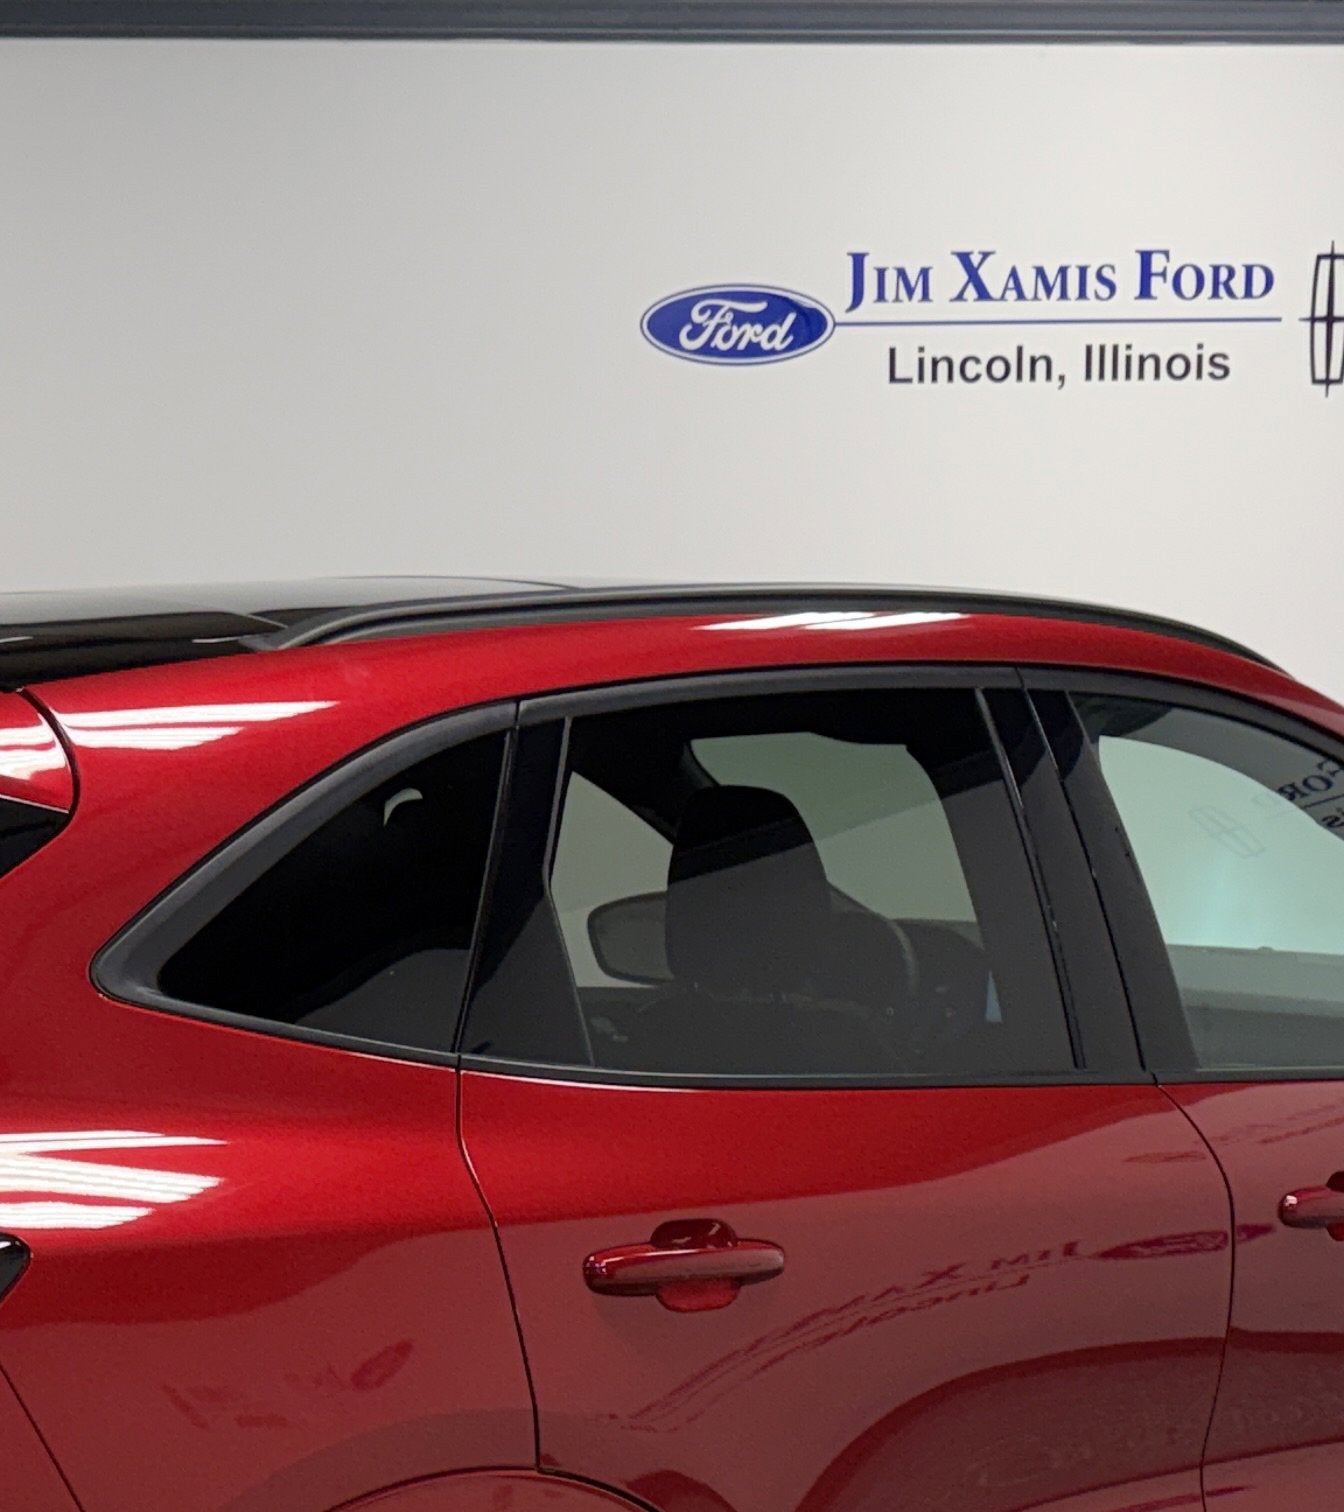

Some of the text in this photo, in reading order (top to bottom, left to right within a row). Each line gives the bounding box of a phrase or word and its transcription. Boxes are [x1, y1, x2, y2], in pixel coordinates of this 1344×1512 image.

[845, 249, 1275, 313] JIM XAMIS FORD
[679, 300, 794, 353] Ford
[888, 343, 1231, 388] Lincoln, Illinois
